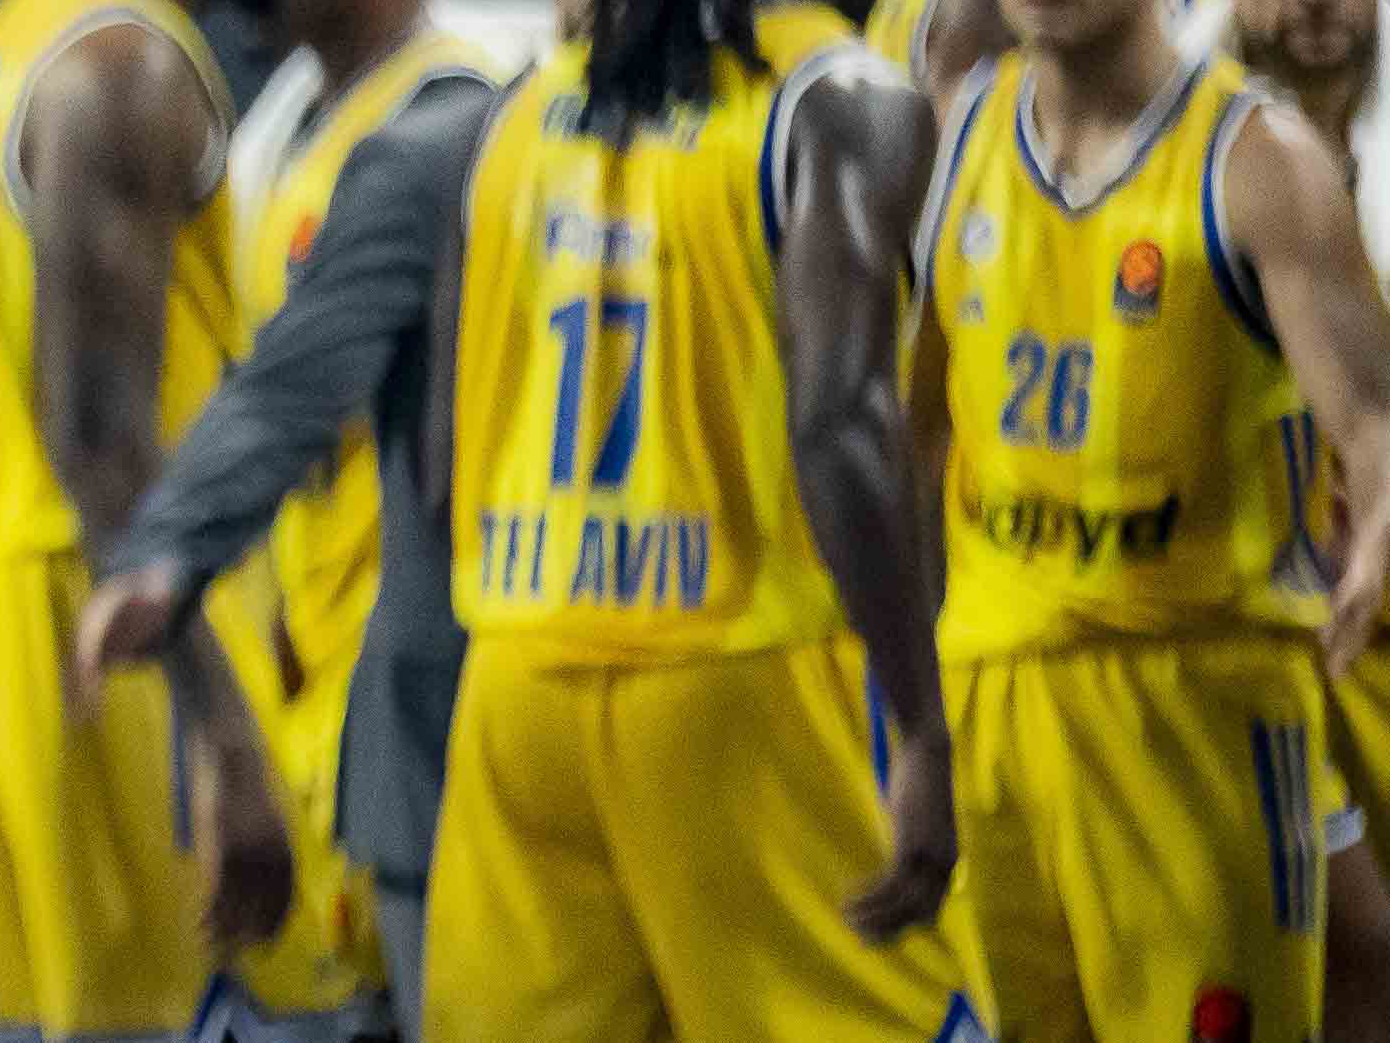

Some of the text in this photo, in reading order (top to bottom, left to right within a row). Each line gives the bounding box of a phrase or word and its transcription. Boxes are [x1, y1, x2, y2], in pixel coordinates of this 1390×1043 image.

[549, 295, 650, 492] 17
[999, 327, 1095, 453] 26
[570, 513, 709, 610] AVIV
